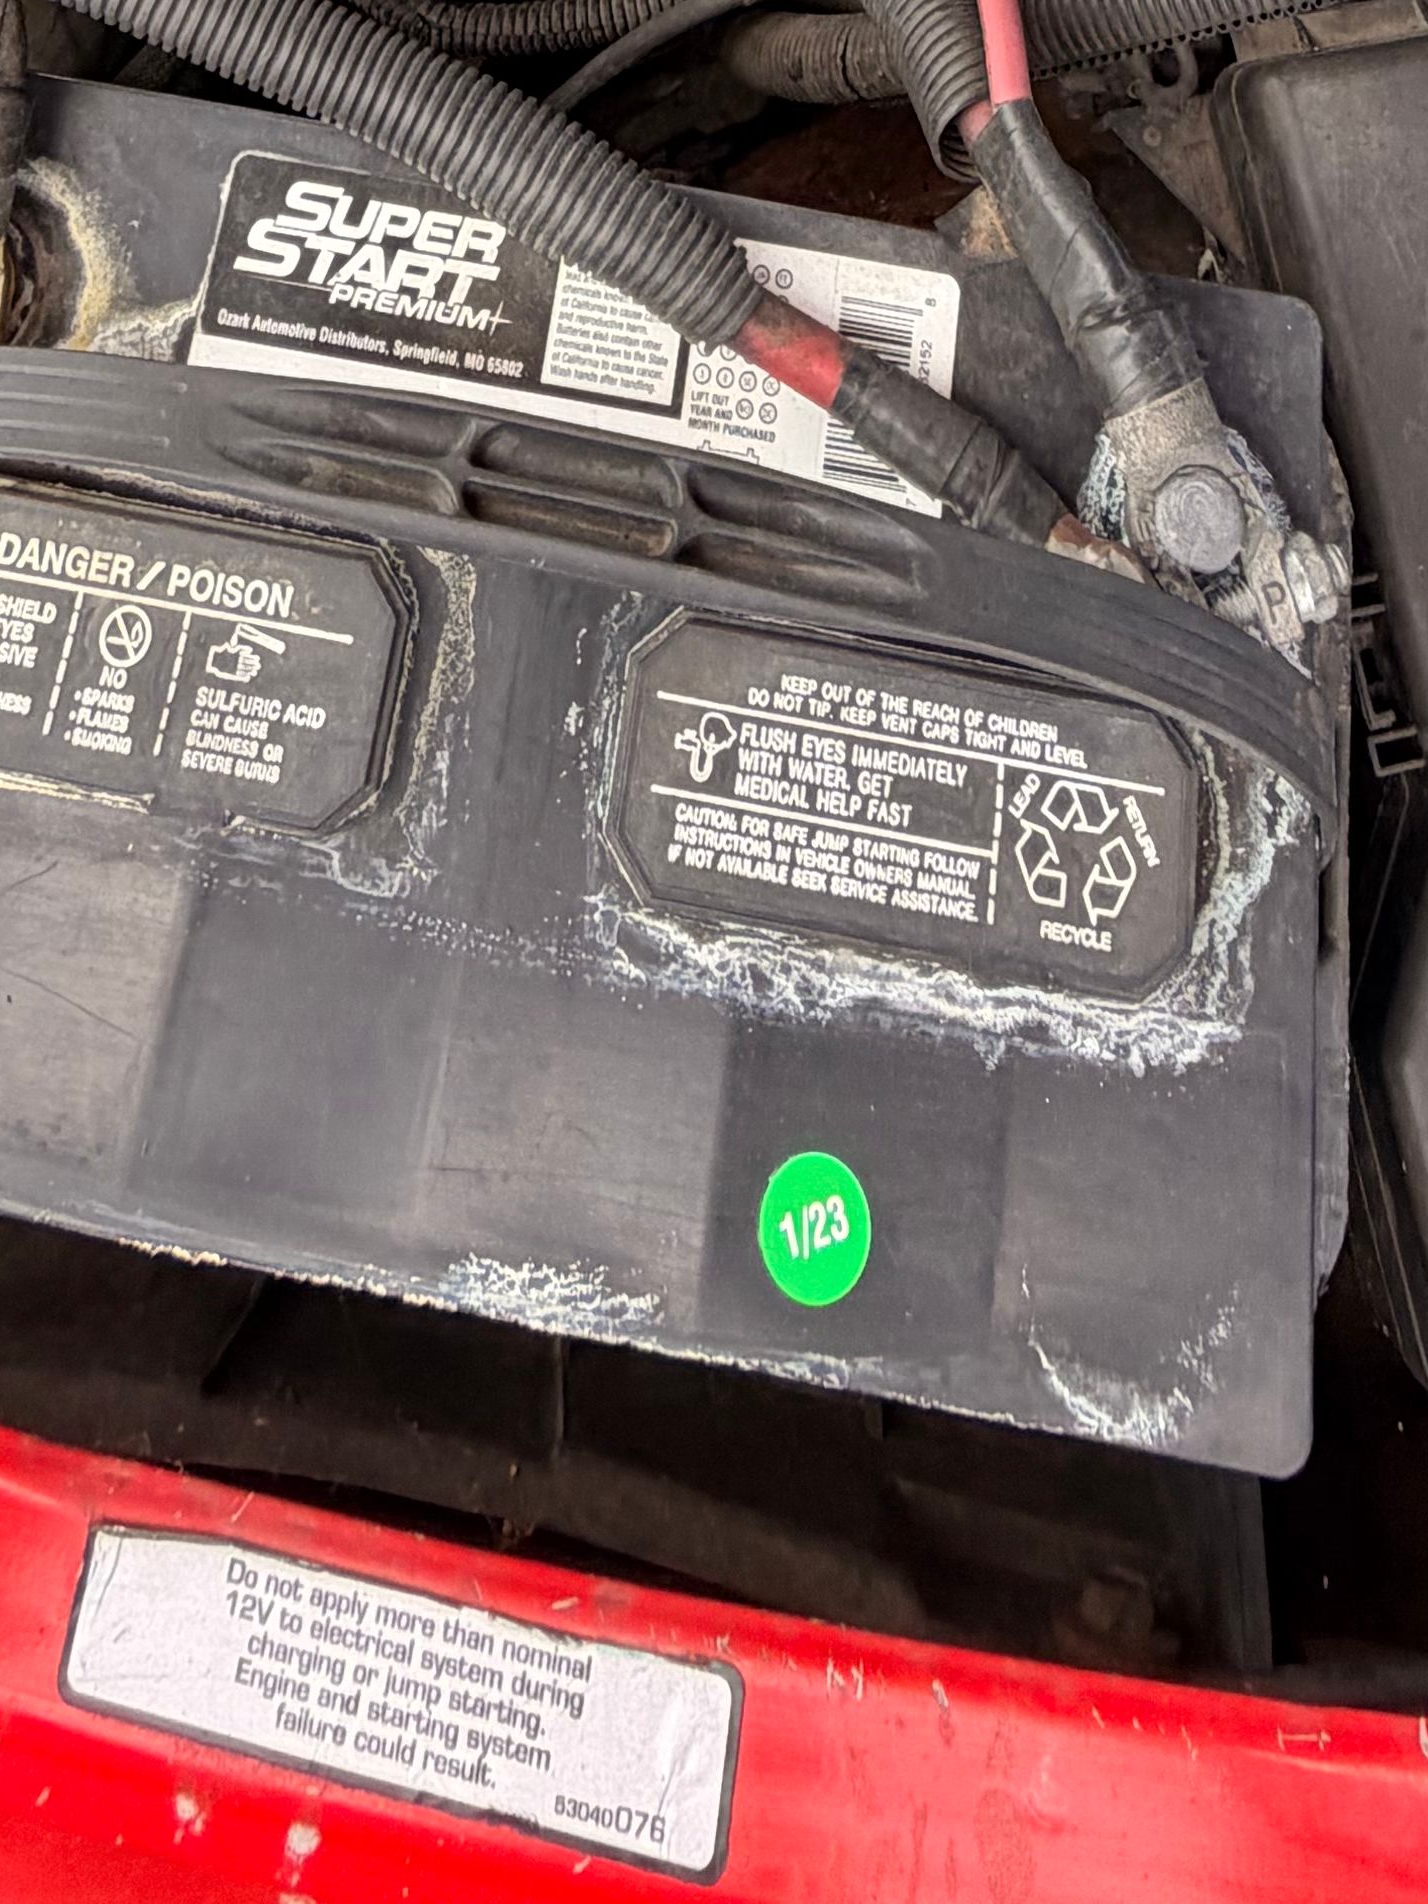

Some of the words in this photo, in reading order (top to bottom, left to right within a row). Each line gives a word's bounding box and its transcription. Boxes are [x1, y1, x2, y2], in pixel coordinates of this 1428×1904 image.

[283, 180, 506, 262] SUPER
[234, 218, 501, 307] START
[925, 296, 937, 308] 8
[217, 307, 250, 330] Ozark
[252, 313, 316, 343] Automotive
[319, 325, 390, 357] Distributors,
[393, 340, 460, 369] Springfield,
[464, 352, 484, 371] MO
[690, 404, 712, 418] YEAR
[714, 408, 733, 421] AND
[691, 391, 710, 404] LIFT
[688, 417, 721, 432] MONTH
[722, 423, 776, 443] PURCHASED
[167, 563, 293, 618] POISON
[1261, 580, 1286, 625] P
[99, 665, 128, 689] NO
[195, 686, 282, 721] SULFURIC
[283, 703, 326, 729] ACID
[781, 674, 817, 696] KEEP
[821, 681, 852, 703] OUT
[855, 688, 876, 707] OF
[880, 691, 909, 714] THE
[913, 699, 960, 724] REACH
[964, 708, 985, 729] OF
[987, 713, 1059, 743] CHILDREN
[185, 729, 260, 759] BLINDNESS
[262, 743, 284, 763] OR
[190, 709, 219, 729] CAN
[223, 714, 269, 740] CAUSE
[739, 722, 797, 754] FLUSH
[802, 733, 846, 764] EYES
[851, 744, 968, 789] IMMEDIATELY
[747, 686, 771, 708] DO
[773, 694, 803, 713] NOT
[808, 697, 834, 720] TIP.
[840, 705, 877, 726] KEEP
[881, 712, 918, 735] VENT
[922, 720, 959, 744] CAPS
[965, 730, 1006, 752] TIGHT
[1010, 738, 1041, 759] AND
[1045, 743, 1088, 769] LEVEL
[181, 748, 234, 775] SEVERE
[738, 747, 783, 777] WITH
[857, 770, 894, 799] GET
[734, 772, 810, 809] MEDICAL
[815, 789, 862, 818] HELP
[866, 798, 913, 828] FAST
[1008, 773, 1041, 819] LEAD
[674, 823, 772, 859] INSTRUCTIONS
[775, 844, 791, 864] IN
[795, 847, 850, 875] VEHICLE
[853, 860, 913, 887] OWNERS
[675, 803, 737, 831] CAUTION:
[741, 814, 770, 837] FOR
[773, 821, 809, 846] SAFE
[811, 830, 848, 852] JUMP
[852, 837, 920, 868] STARTING
[923, 850, 980, 879] FOLLOW
[1123, 795, 1160, 868] RETURN
[667, 842, 682, 863] IF
[685, 848, 715, 870] NOT
[717, 854, 789, 886] AVAILABLE
[791, 867, 827, 893] SEEK
[831, 876, 888, 905] SERVICE
[1040, 920, 1113, 952] RECYCLE
[779, 1194, 849, 1260] 1/23
[226, 1557, 258, 1589] Do
[264, 1573, 305, 1603] not
[310, 1587, 369, 1626] apply
[375, 1604, 435, 1639] more
[443, 1618, 494, 1656] than
[502, 1639, 593, 1684] nominal
[226, 1590, 274, 1626] 12V
[279, 1607, 302, 1634] to
[310, 1616, 415, 1667] electrical
[420, 1650, 504, 1691] system
[511, 1670, 585, 1720] during
[247, 1631, 346, 1686] charging
[352, 1663, 379, 1687] or
[382, 1665, 442, 1713] jump
[449, 1690, 546, 1741] starting.
[234, 1656, 310, 1702] Engine
[317, 1689, 361, 1717] and
[367, 1700, 459, 1751] starting
[467, 1729, 552, 1772] system
[276, 1702, 347, 1746] failure
[353, 1730, 417, 1767] could
[422, 1749, 496, 1790] result.
